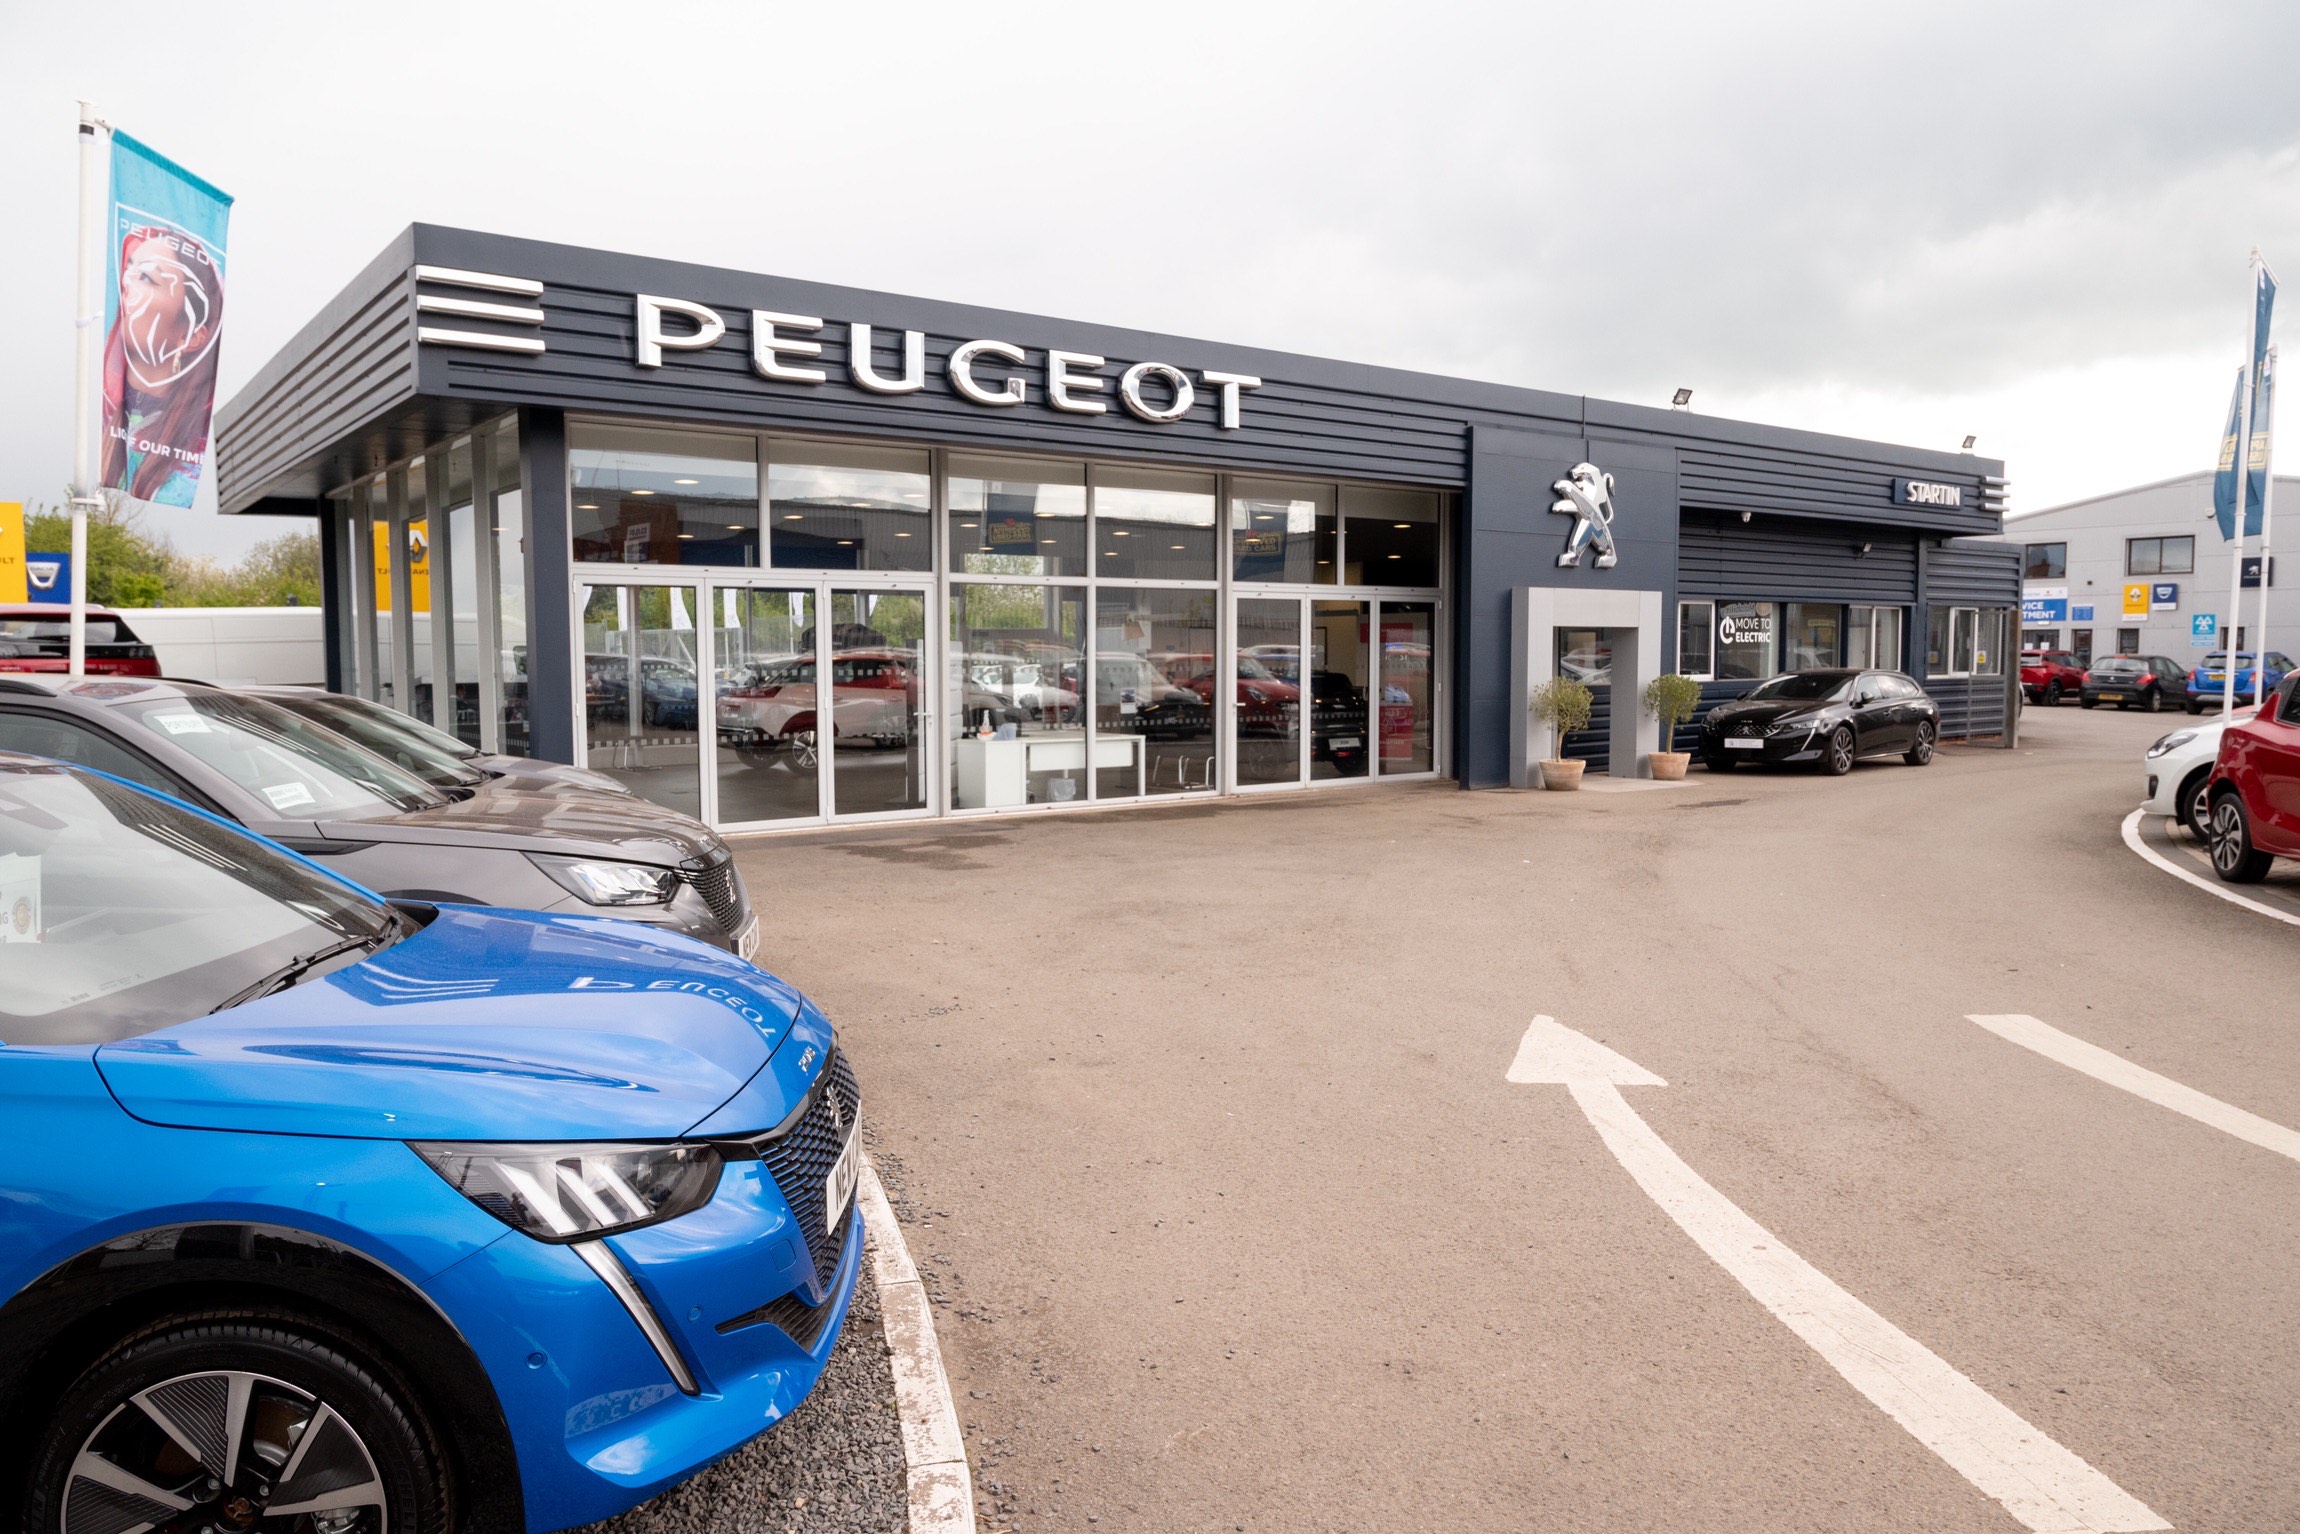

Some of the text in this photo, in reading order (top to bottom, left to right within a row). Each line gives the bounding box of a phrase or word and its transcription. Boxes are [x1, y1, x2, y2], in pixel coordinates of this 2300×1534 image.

[634, 293, 1262, 430] PEUGEOT
[139, 440, 171, 457] OUR
[1907, 482, 1960, 506] STARTIN
[1735, 618, 1771, 629] MOVE TO
[1735, 631, 1771, 643] ELECTRIC
